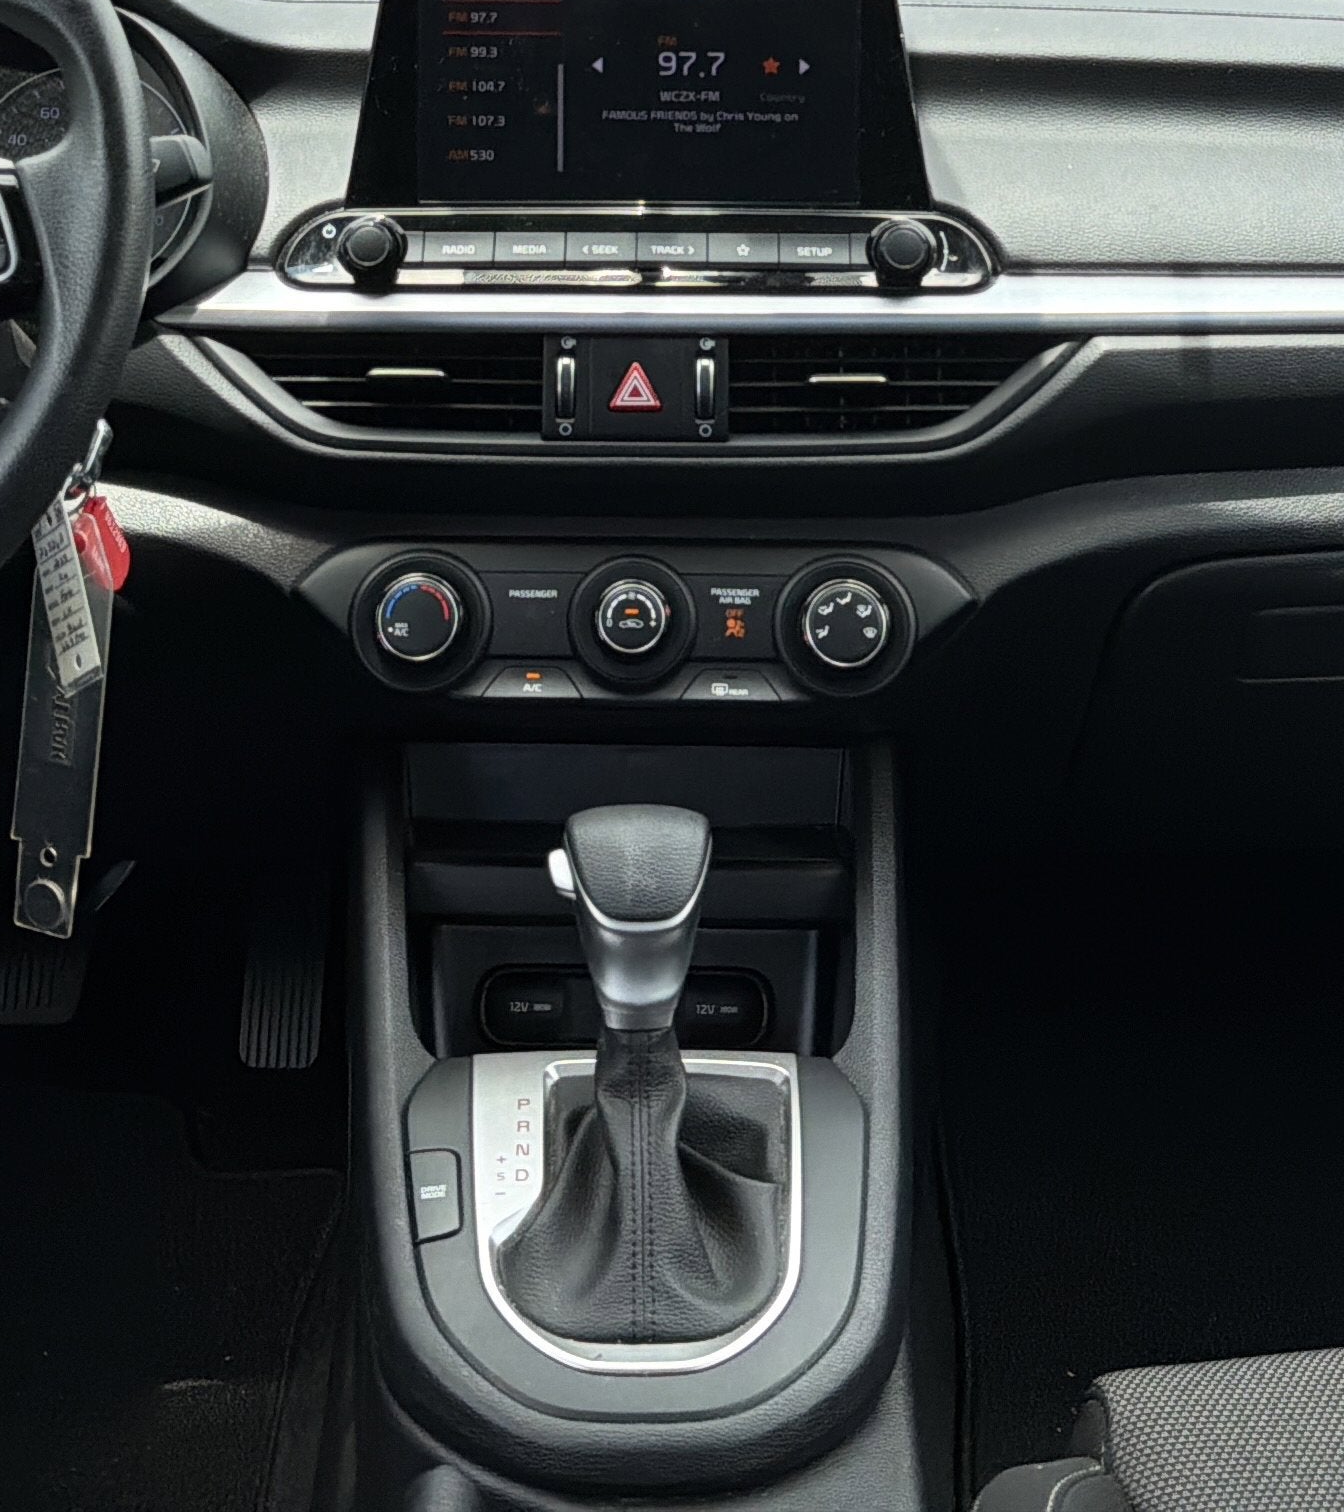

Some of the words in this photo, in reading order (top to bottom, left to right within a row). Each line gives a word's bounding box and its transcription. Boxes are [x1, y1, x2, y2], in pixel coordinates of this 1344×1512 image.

[448, 11, 468, 23] FM
[469, 11, 498, 24] 97.7
[469, 46, 498, 59] 99.3
[657, 51, 727, 79] 97.7
[471, 80, 506, 93] 104.7
[659, 90, 721, 103] WCZX-FM
[39, 106, 61, 120] 60
[601, 109, 649, 122] FAMOUS
[650, 109, 699, 122] FRIENDS
[699, 110, 715, 123] by
[716, 109, 745, 122] Chris
[746, 110, 783, 124] Young
[783, 112, 800, 123] on
[471, 114, 506, 128] 107.3
[672, 122, 694, 134] The
[694, 122, 722, 134] Wolf
[7, 133, 28, 147] 40
[469, 149, 496, 162] 530
[441, 244, 477, 256] RADIO
[511, 244, 548, 255] MEDIA
[591, 244, 620, 256] SEEK
[650, 244, 686, 256] TRACK
[796, 245, 834, 257] SETUP
[508, 588, 559, 599] PASSENGER
[710, 587, 761, 598] PASSENGER
[718, 596, 734, 605] AIR
[734, 596, 752, 605] BAG
[393, 628, 410, 637] A/C
[522, 682, 544, 693] A/C
[728, 688, 750, 696] REAR
[509, 1001, 531, 1013] 12V
[696, 1004, 716, 1015] 12V
[517, 1098, 531, 1110] P
[516, 1120, 530, 1132] R
[515, 1144, 530, 1156] N
[496, 1172, 506, 1181] S
[515, 1169, 530, 1182] D
